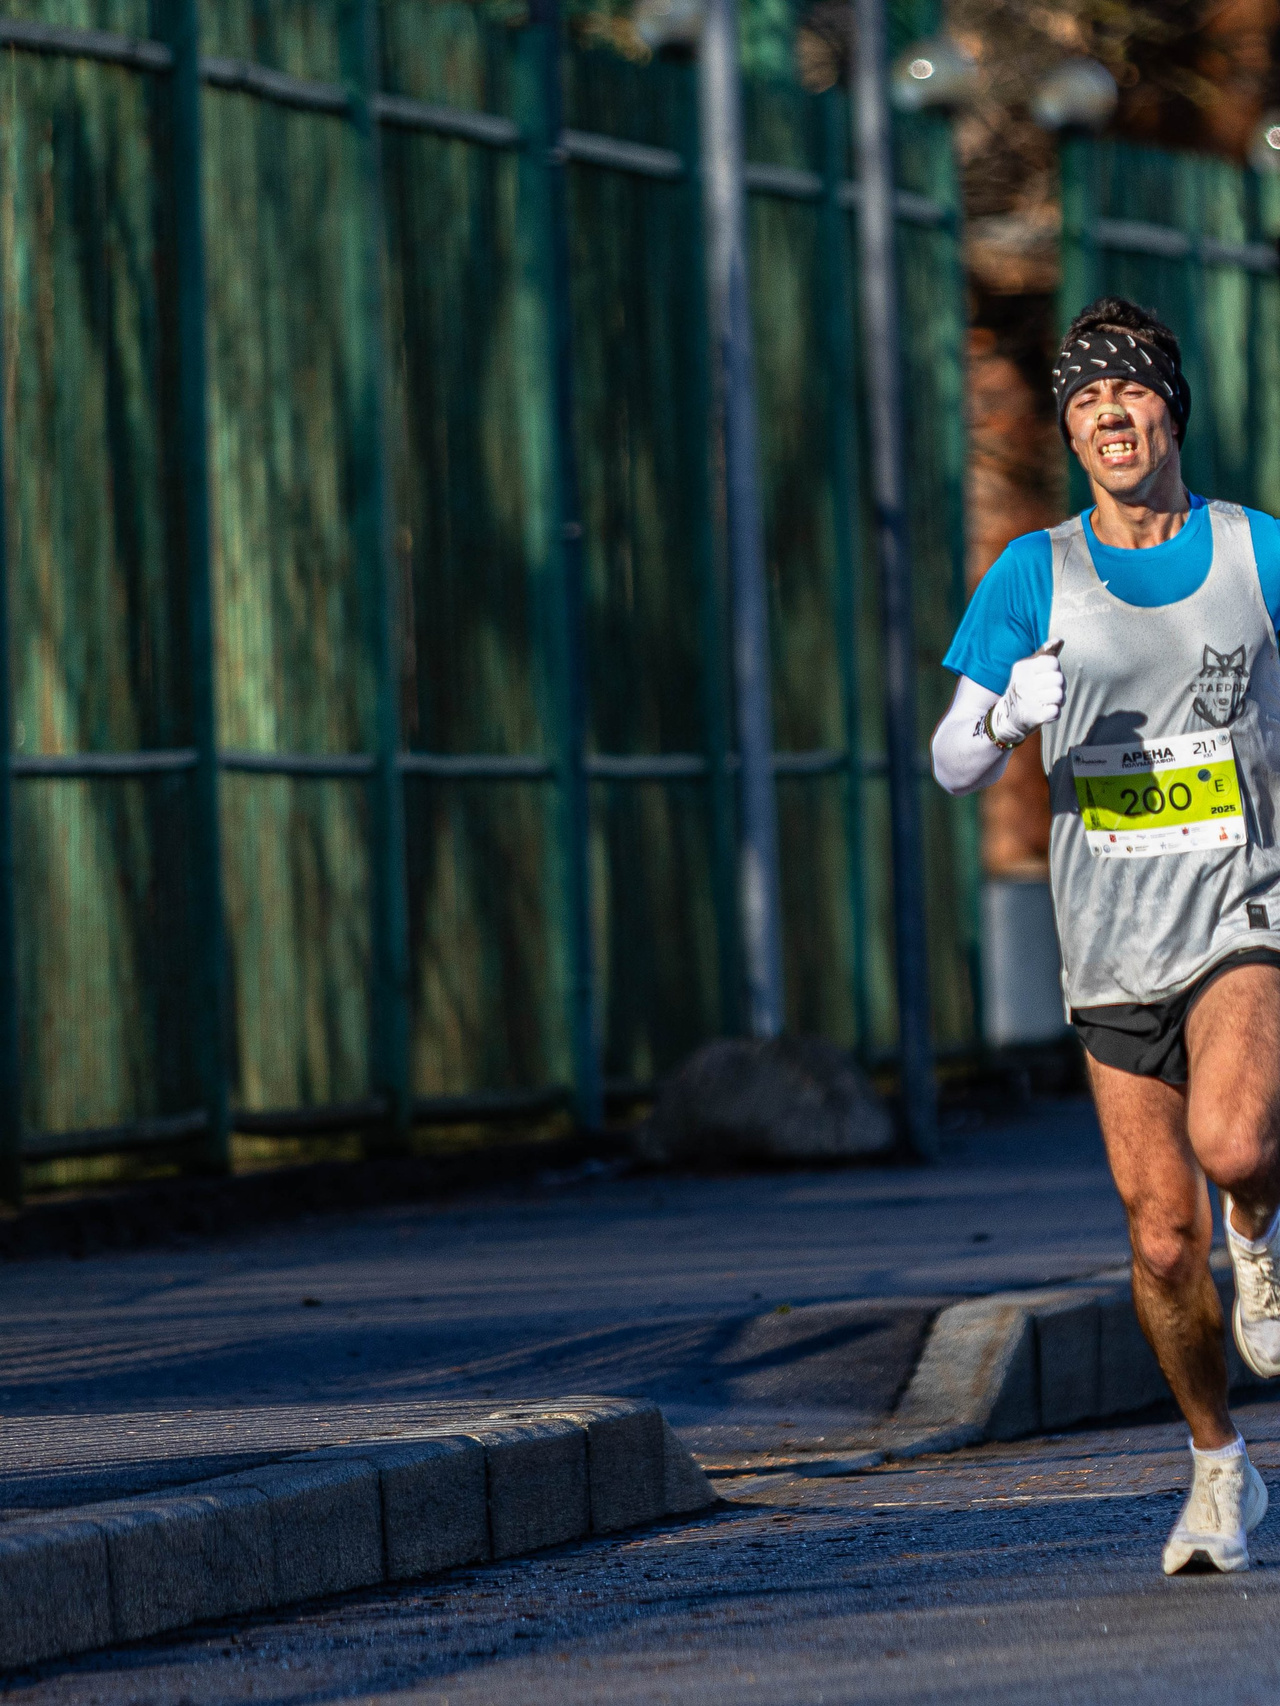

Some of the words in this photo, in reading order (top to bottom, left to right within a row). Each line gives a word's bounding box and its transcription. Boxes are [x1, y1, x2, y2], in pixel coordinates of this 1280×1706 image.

[1122, 747, 1174, 763] АРЕНА
[1121, 757, 1176, 769] ПОЛУМАРАФОН
[1120, 782, 1192, 816] 200
[1211, 804, 1237, 815] 2025
